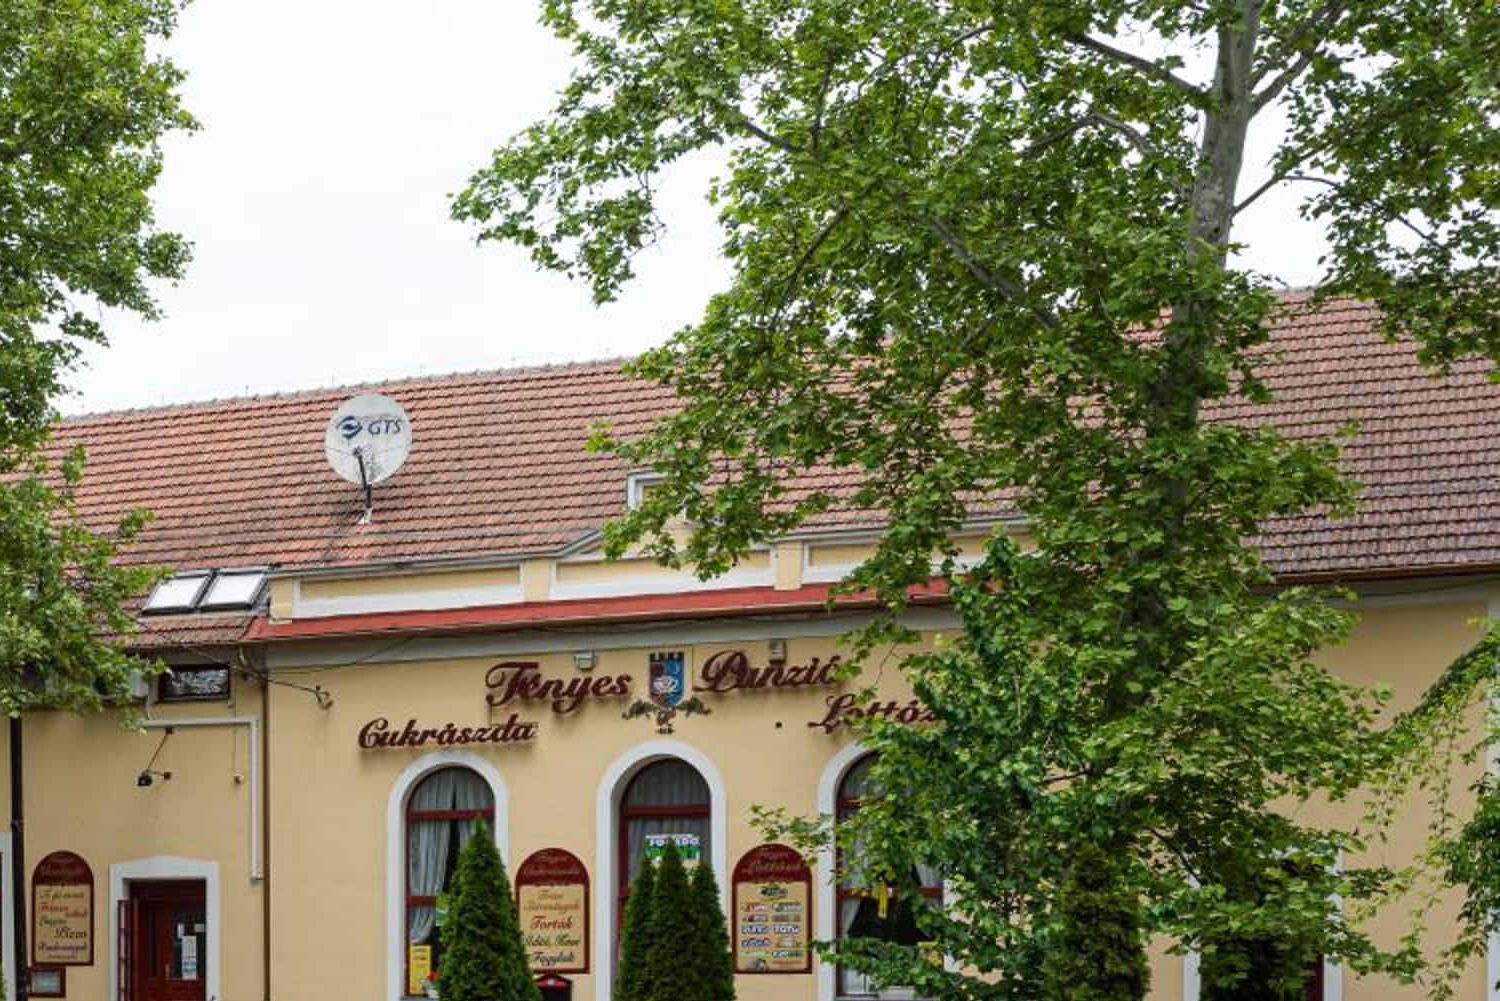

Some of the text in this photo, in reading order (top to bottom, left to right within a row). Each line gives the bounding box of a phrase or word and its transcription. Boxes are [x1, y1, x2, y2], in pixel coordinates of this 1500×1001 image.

[367, 417, 403, 435] GTS
[485, 661, 633, 714] Fényes
[358, 713, 536, 749] Cukrászda
